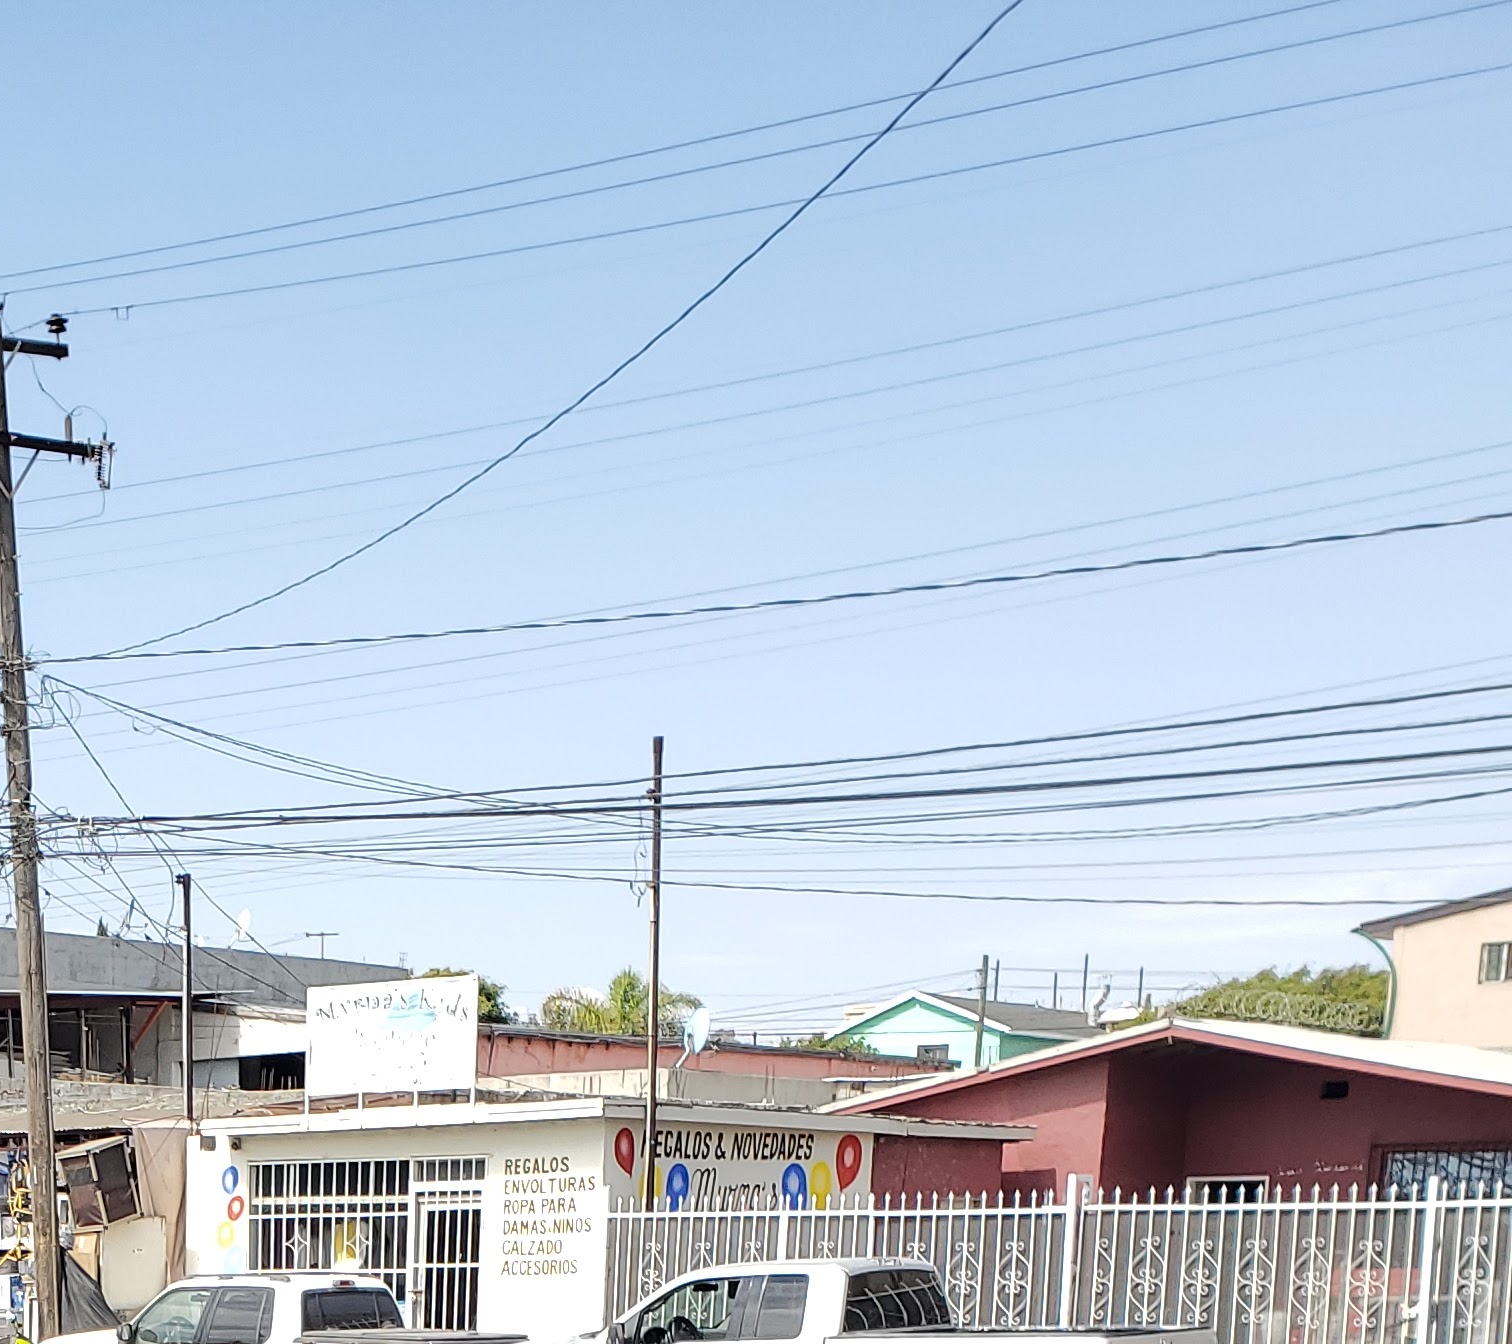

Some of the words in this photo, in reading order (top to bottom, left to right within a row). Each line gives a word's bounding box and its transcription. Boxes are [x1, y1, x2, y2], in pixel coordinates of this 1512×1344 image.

[714, 1132, 727, 1160] &
[730, 1132, 815, 1161] NOVEDADES
[504, 1156, 570, 1176] REGALOS
[504, 1176, 596, 1195] ENVOLTURAS
[503, 1199, 536, 1215] ROPA
[541, 1197, 577, 1214] PARA
[502, 1239, 563, 1256] CALZADO
[500, 1259, 578, 1276] ACCESORIOS
